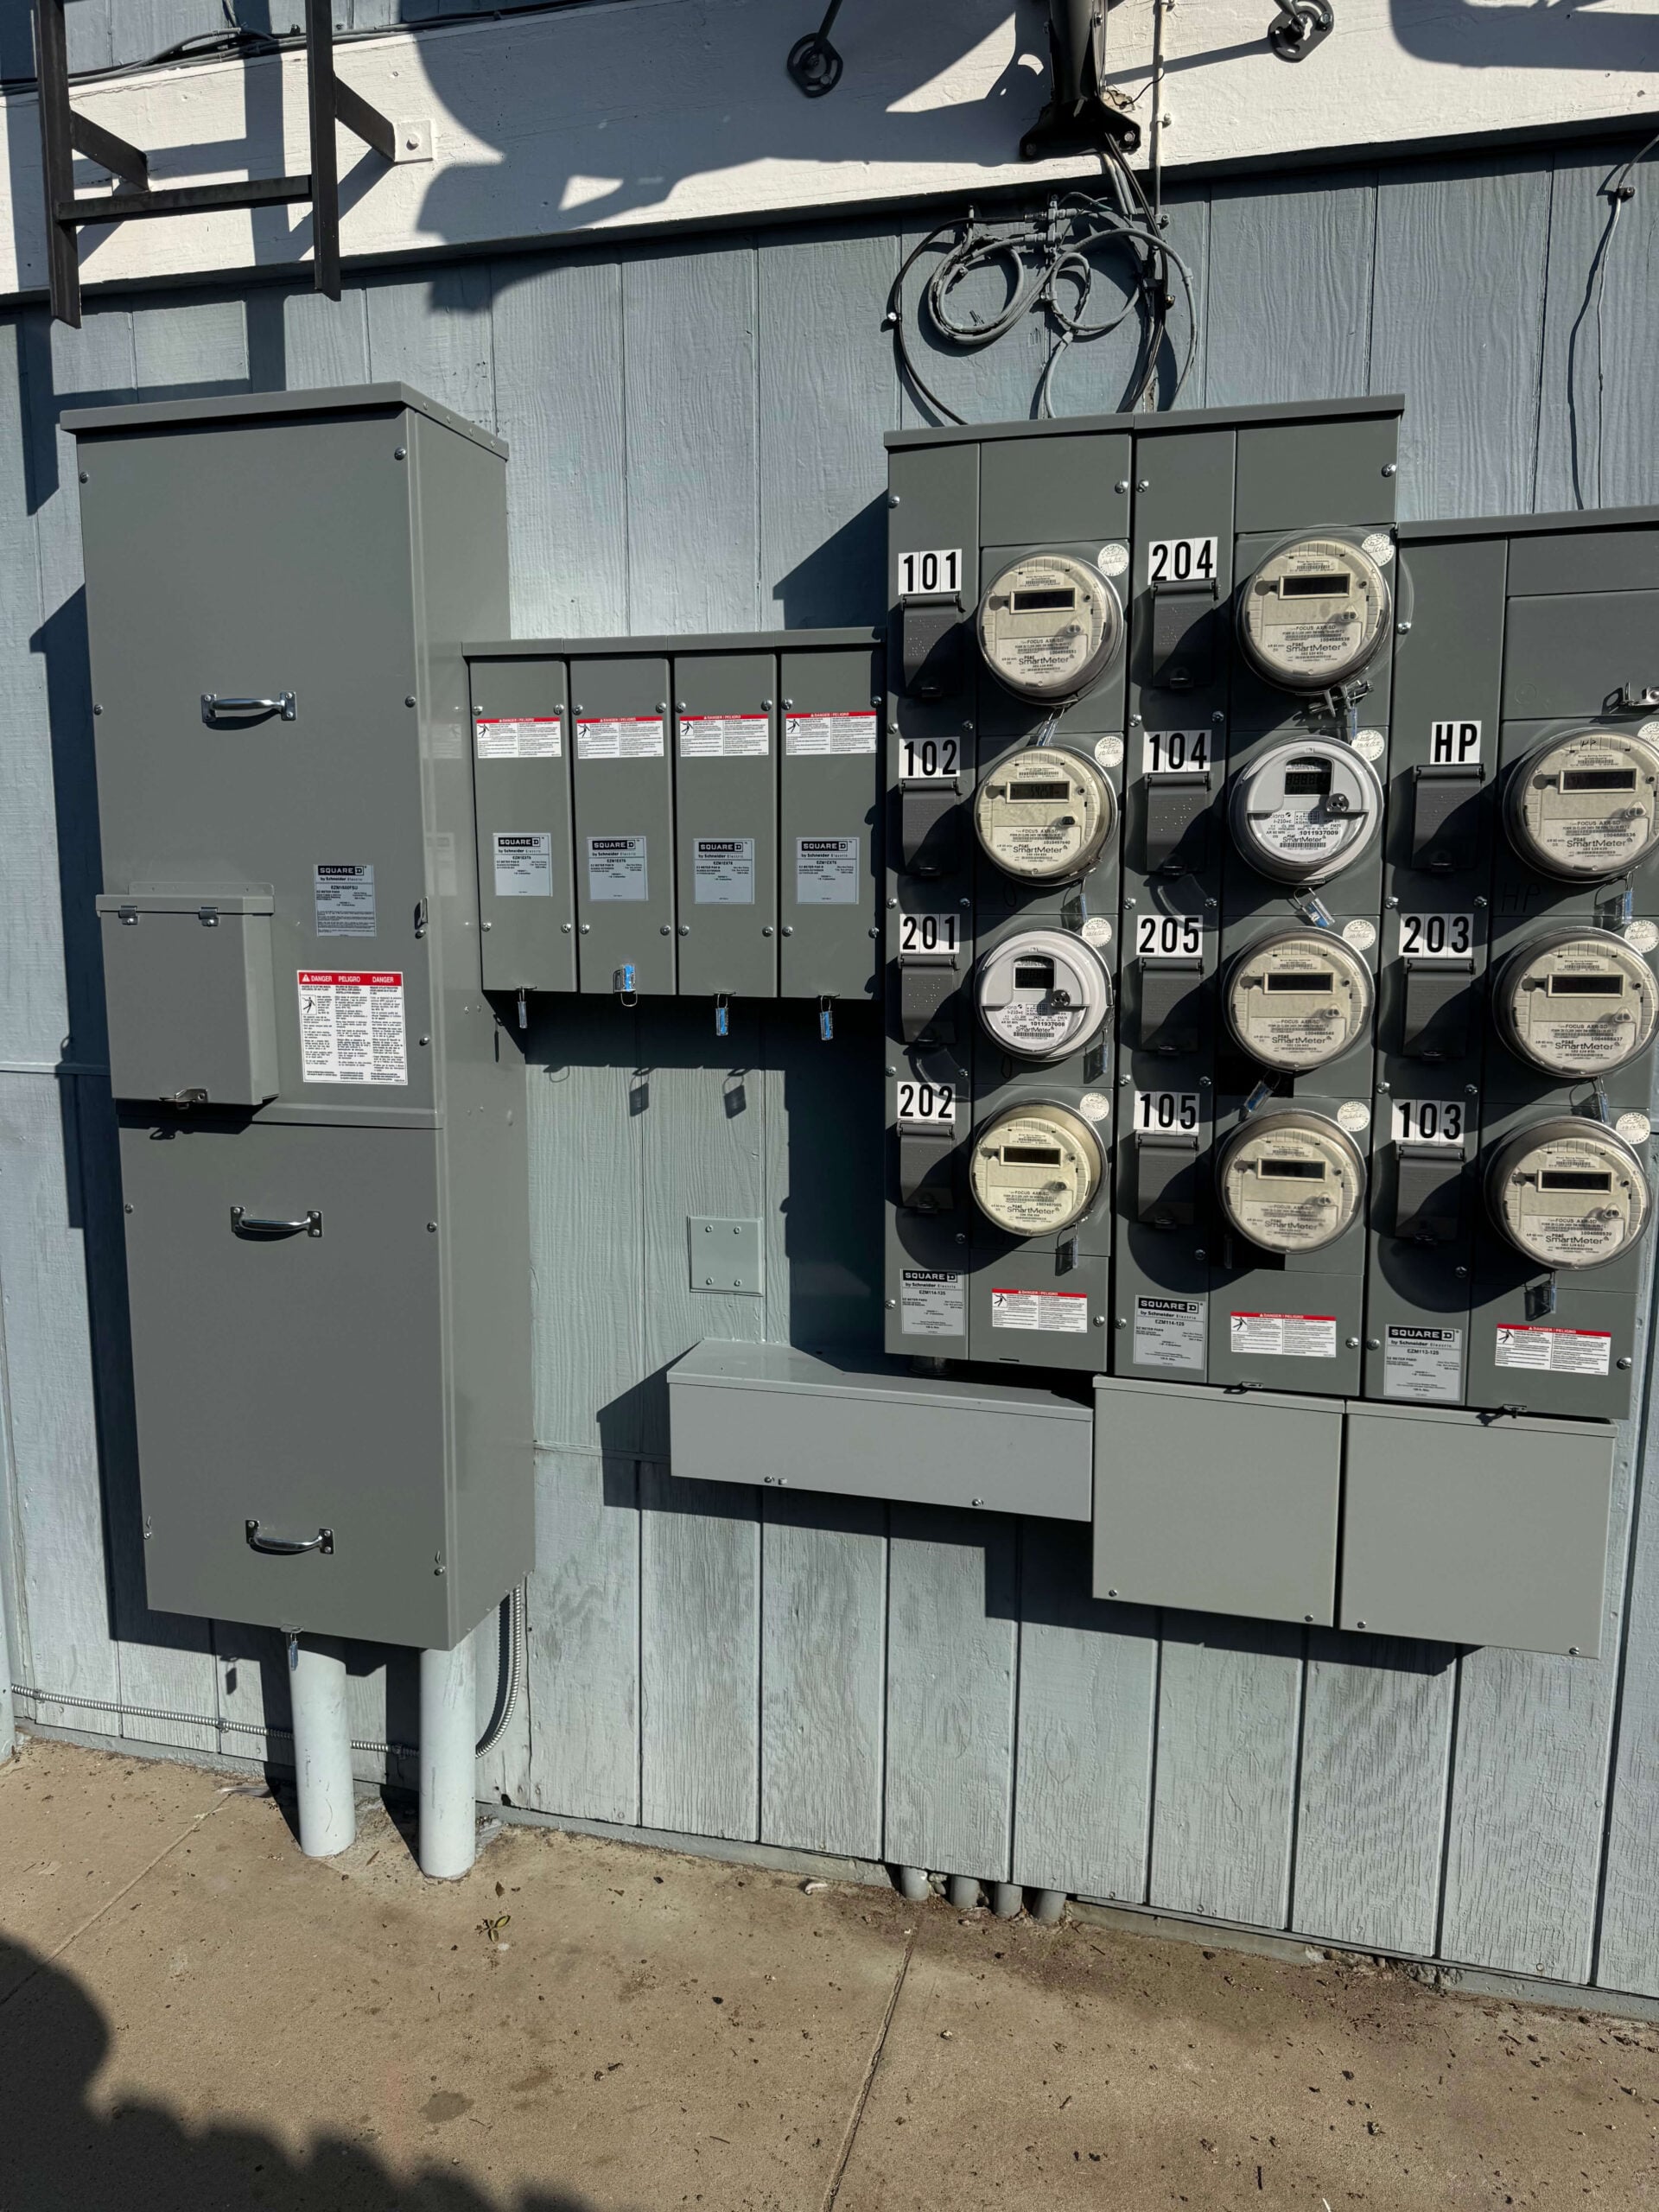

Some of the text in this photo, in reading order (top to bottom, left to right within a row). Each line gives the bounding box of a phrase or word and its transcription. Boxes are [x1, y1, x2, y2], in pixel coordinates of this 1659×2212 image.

[904, 551, 956, 592] 101
[1151, 540, 1213, 582] 204
[1019, 657, 1069, 665] SmartMeter
[1286, 644, 1340, 652] SmartMeter
[904, 740, 957, 776] 102
[1149, 733, 1207, 771] 104
[1434, 723, 1478, 762] HP
[1501, 883, 1541, 912] HP
[902, 916, 954, 950] 201
[1140, 918, 1198, 953] 205
[1402, 916, 1469, 953] 203
[899, 1084, 952, 1118] 202
[1140, 1093, 1196, 1129] 105
[1399, 1103, 1461, 1140] 103
[1265, 1220, 1317, 1230] SmartMeter
[1546, 1236, 1603, 1244] SmartMeter
[1141, 1300, 1185, 1311] SQUARE
[1391, 1329, 1440, 1338] SQUARE
